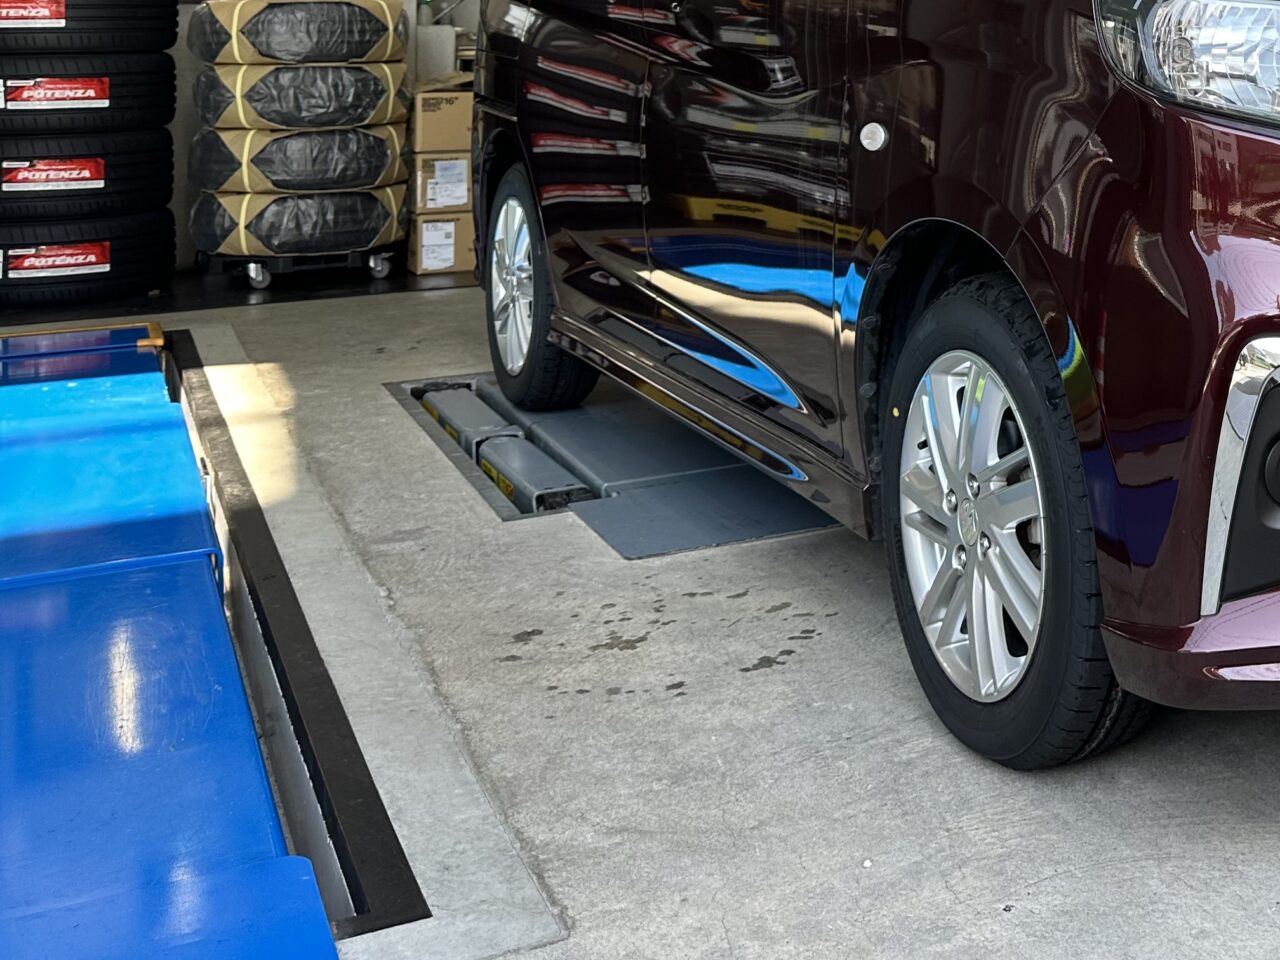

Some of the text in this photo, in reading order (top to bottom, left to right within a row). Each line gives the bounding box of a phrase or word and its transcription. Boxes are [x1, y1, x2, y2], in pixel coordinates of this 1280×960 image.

[22, 89, 96, 98] POTENZA
[17, 170, 91, 180] POTENZA
[24, 254, 97, 266] POTENZA
